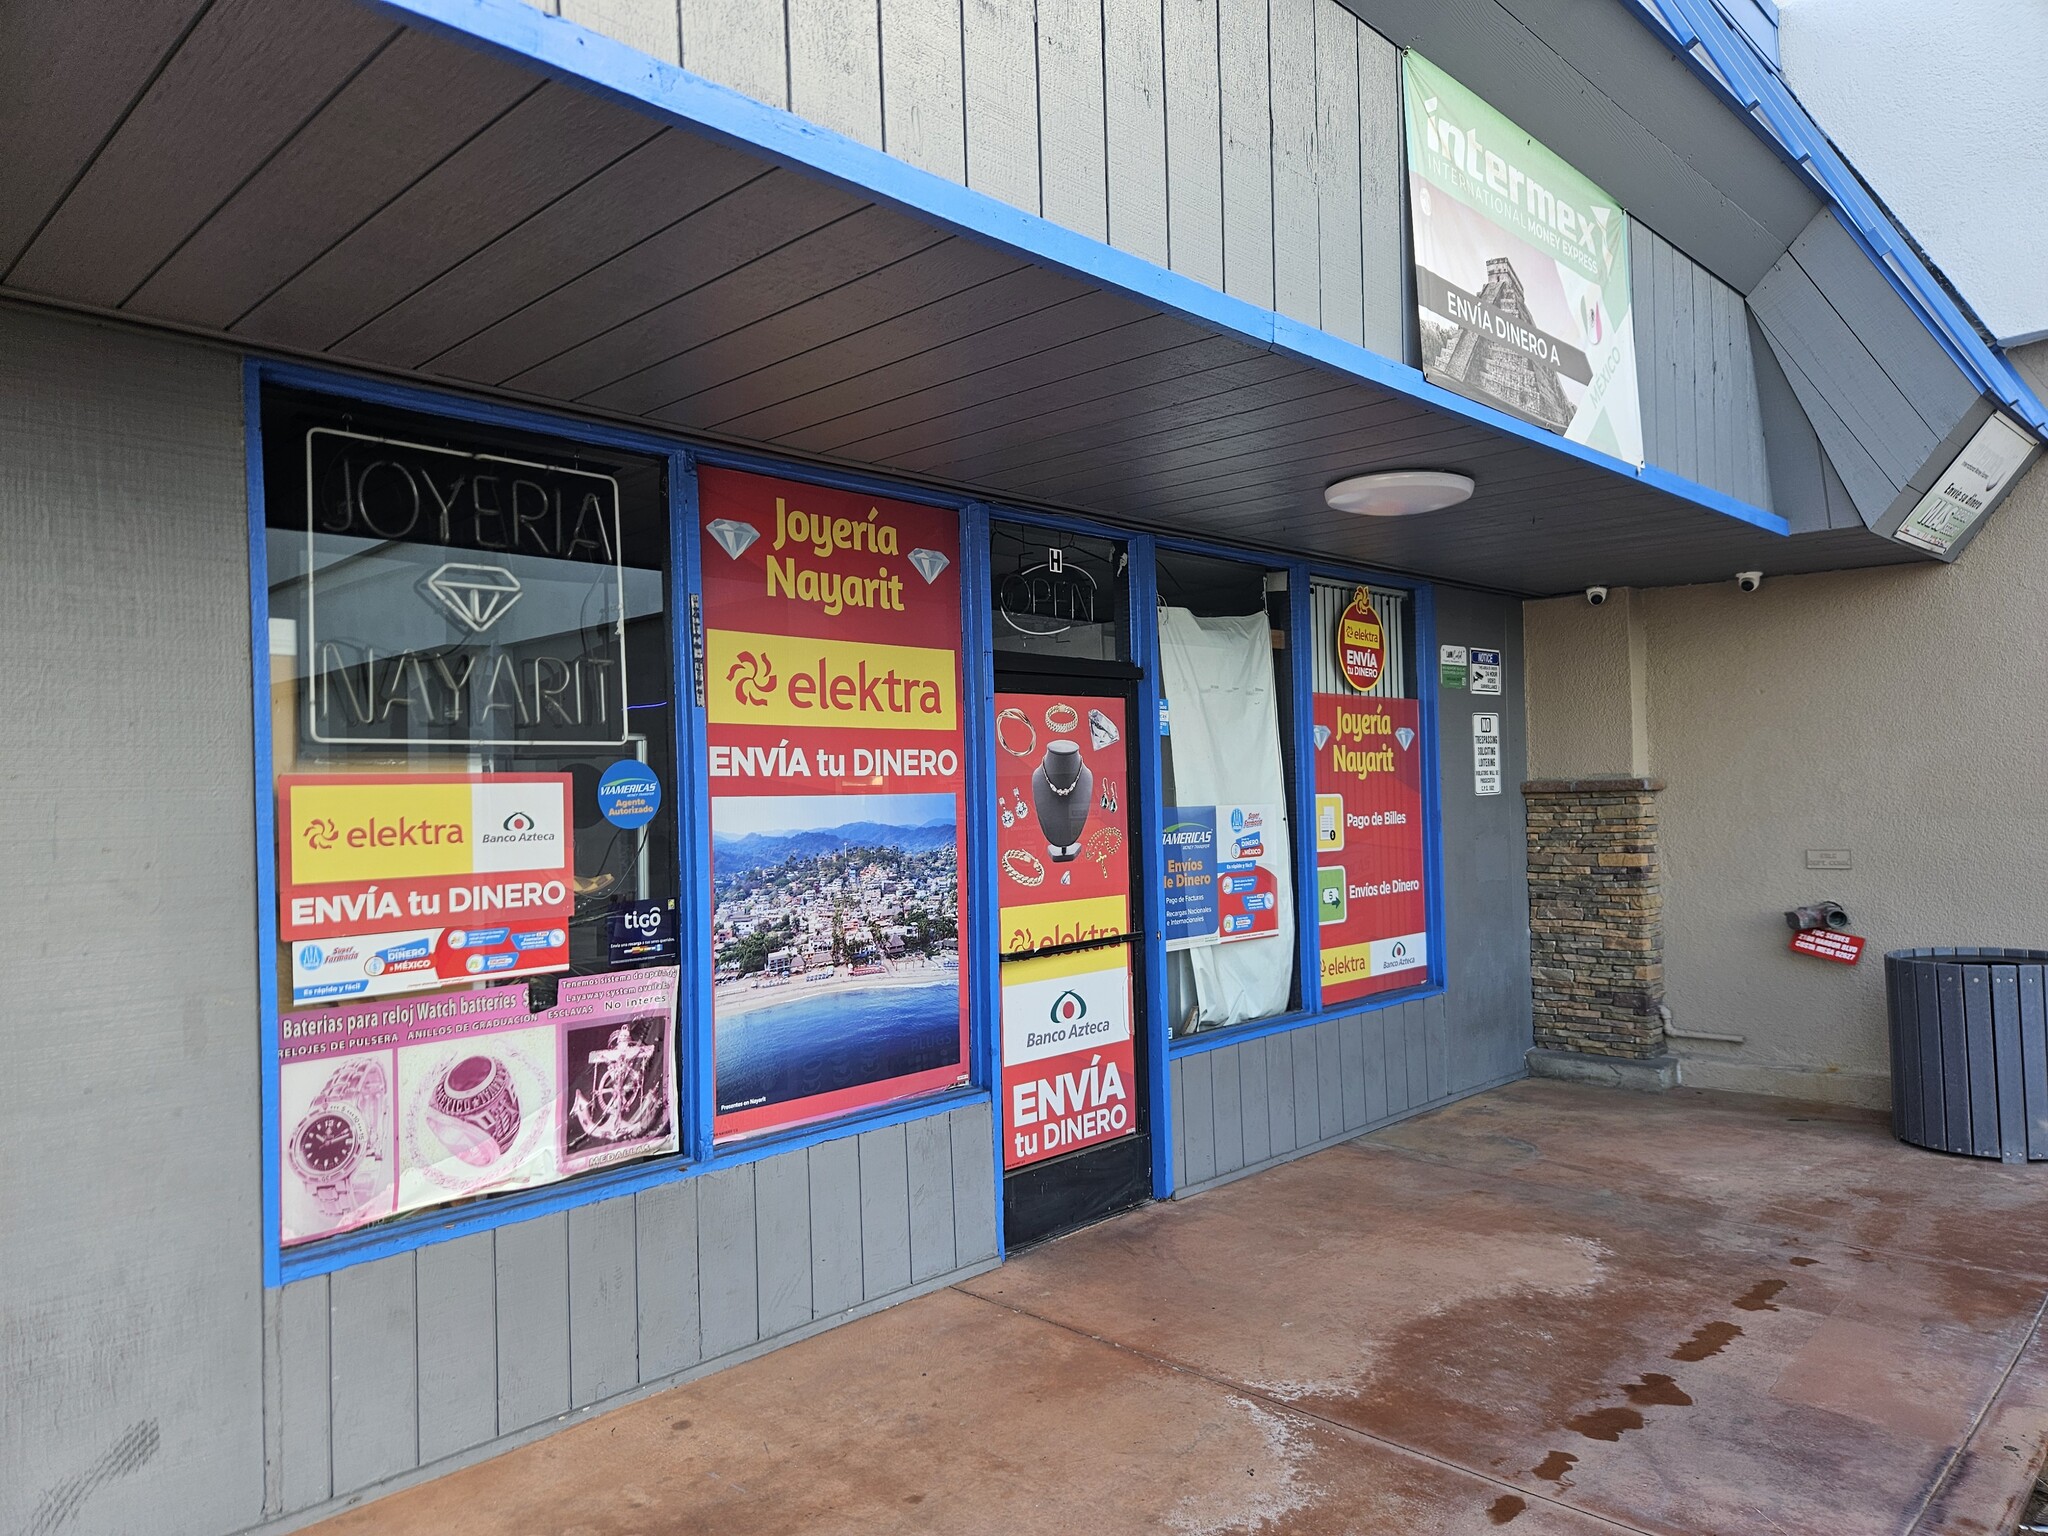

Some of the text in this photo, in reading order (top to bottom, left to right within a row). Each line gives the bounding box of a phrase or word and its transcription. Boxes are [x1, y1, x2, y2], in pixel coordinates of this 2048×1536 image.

[1424, 96, 1598, 256] intermex
[1428, 154, 1599, 275] INTERNATIONAL MONEY EXPRESS
[1446, 290, 1561, 367] ENVÍA DINERO A
[1589, 346, 1622, 410] MÉXICO
[322, 458, 613, 564] JOYERIA
[772, 497, 900, 557] Joyería
[766, 554, 905, 616] Nayarit
[1354, 628, 1379, 643] elektra
[1347, 649, 1378, 669] ENVÍA
[322, 642, 615, 725] NAYARIT
[1347, 665, 1378, 679] tu DINERO
[788, 657, 942, 714] elektra
[1335, 703, 1392, 743] Joyería
[709, 739, 958, 778] ENVÍA tu DINERO
[1332, 743, 1395, 781] Nayarit
[600, 782, 657, 796] VIAMERICAS
[608, 805, 654, 816] Autorizado
[616, 798, 646, 808] Agente
[346, 816, 555, 849] elektra Banco Azteca
[1347, 811, 1407, 830] Pago de Billes
[1168, 858, 1203, 873] Envíos
[1176, 873, 1212, 888] Dinero
[1348, 879, 1420, 899] Envíos de Dinero
[291, 879, 566, 926] ENVÍA tu DINERO
[1166, 897, 1178, 905] Pago
[1185, 894, 1205, 903] Facturas
[1187, 906, 1212, 915] Nacionales
[387, 947, 427, 961] DINERO
[394, 959, 431, 972] MÉXICO
[1328, 955, 1366, 976] elektra
[1383, 961, 1399, 970] Banco
[313, 985, 338, 997] rápido
[339, 985, 344, 993] y
[344, 982, 361, 991] fácil
[562, 979, 598, 989] Tenemos
[600, 973, 631, 985] sistema
[633, 971, 644, 980] de
[566, 991, 605, 1003] Layaway
[606, 986, 636, 998] system
[605, 994, 667, 1010] No interes
[282, 1014, 344, 1040] Baterias
[346, 1011, 379, 1035] para
[382, 1003, 414, 1028] reloj
[416, 997, 457, 1021] Watch
[460, 991, 517, 1015] batteries
[278, 1005, 594, 1059] RELOJES DE PULSERA ANILLOS DE GRADUACION ESCLAVAS
[1026, 1019, 1110, 1048] Banco Azteca
[1013, 1054, 1127, 1128] ENVÍA
[1015, 1103, 1128, 1158] tu DINERO
